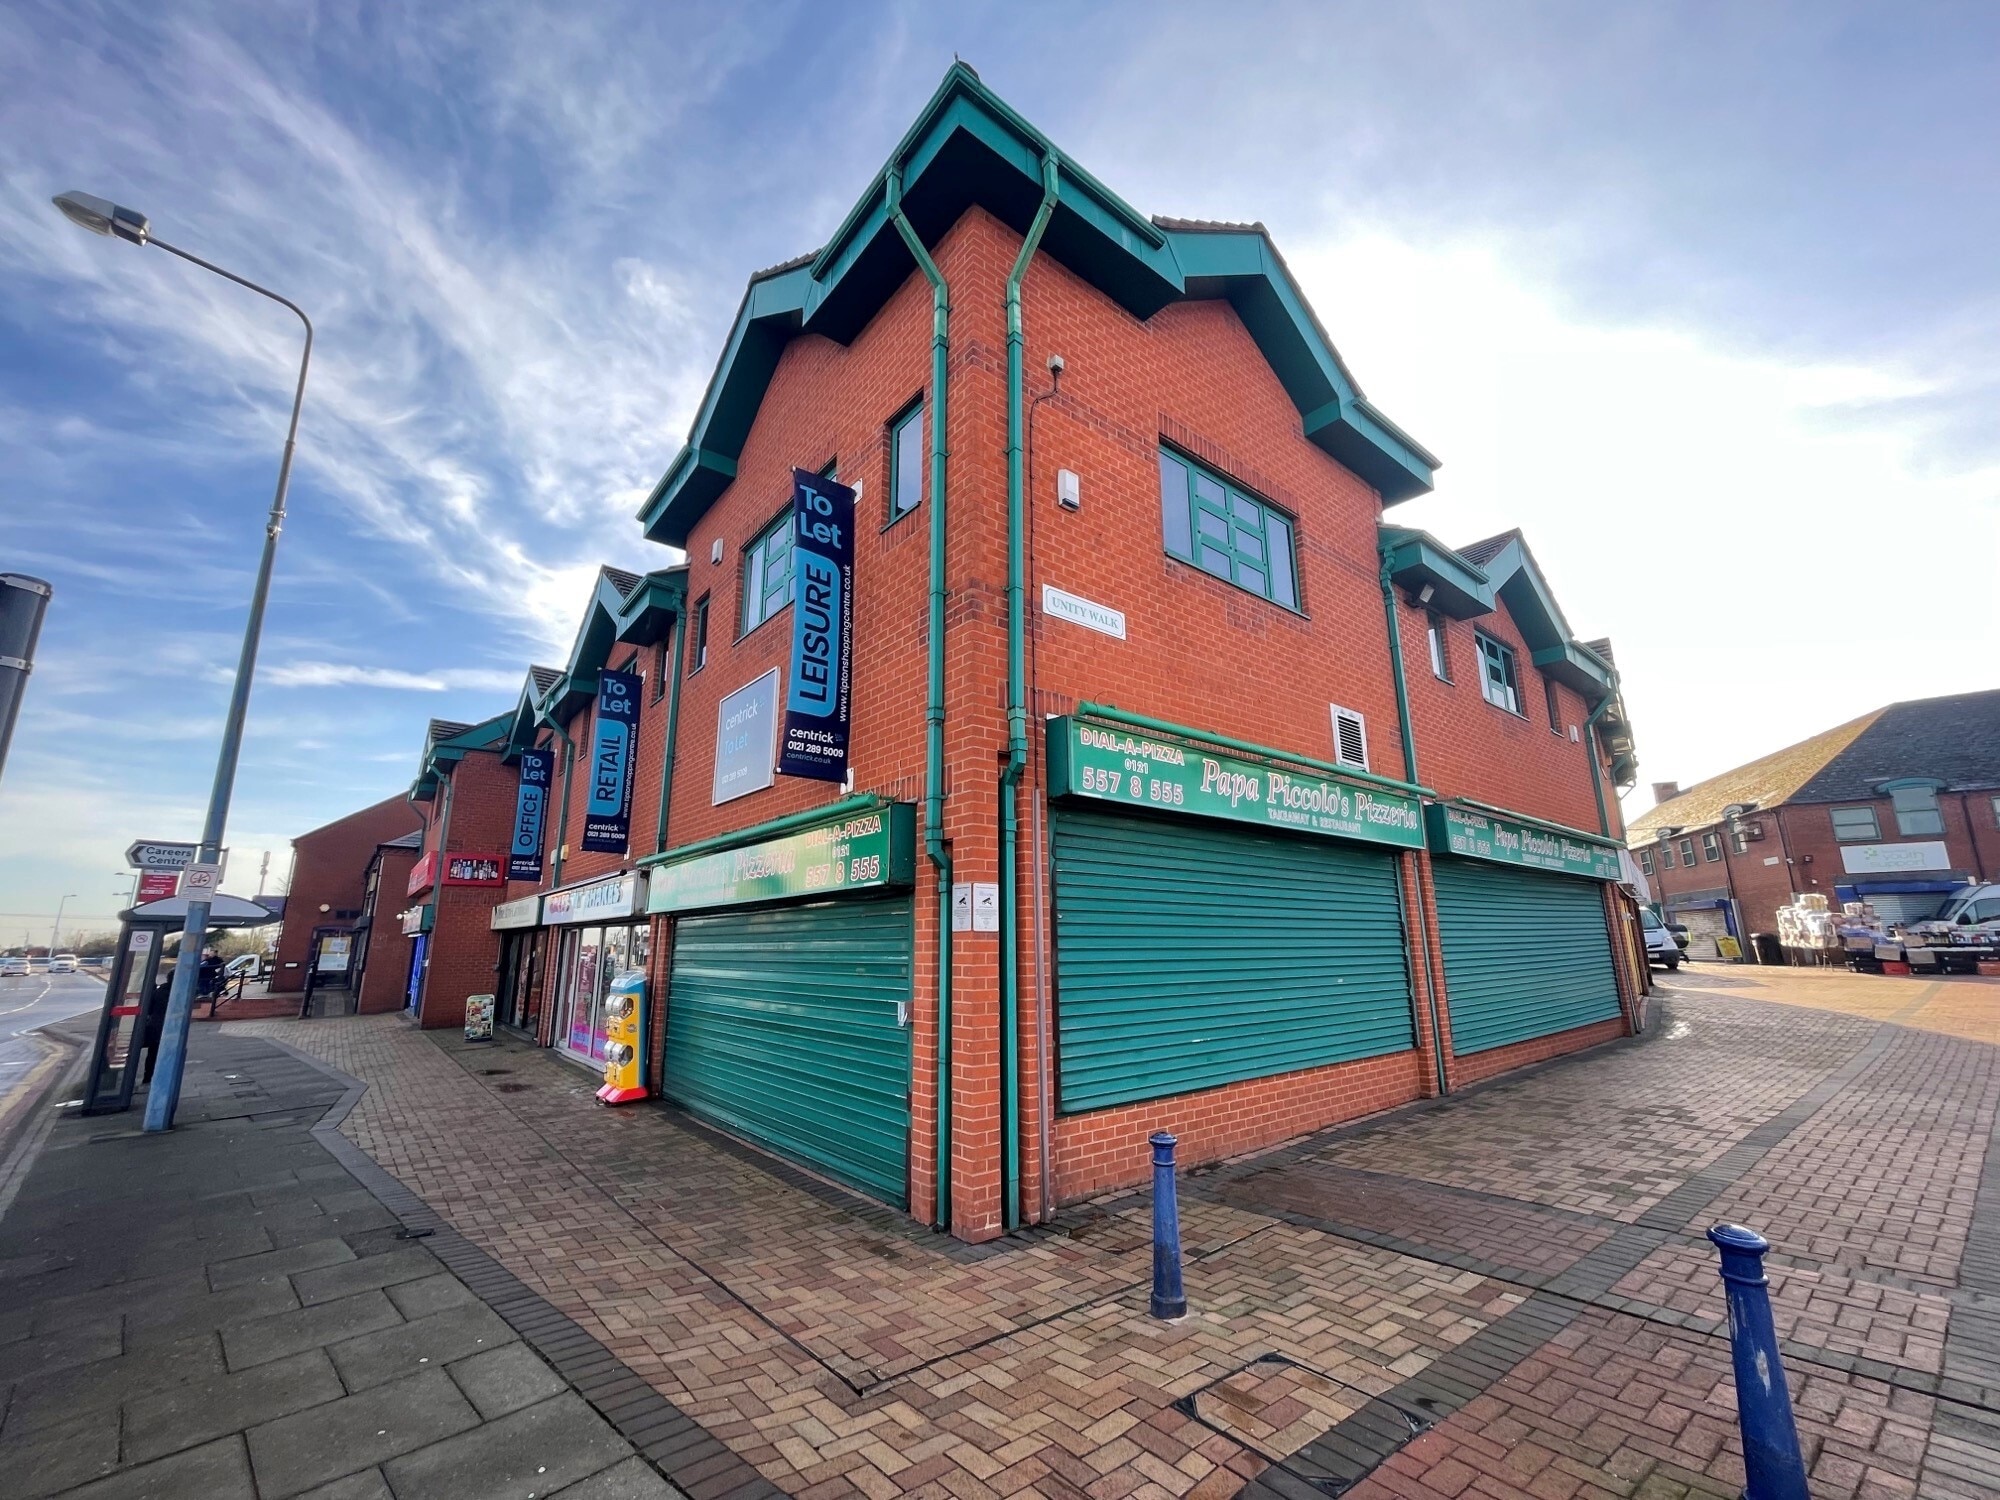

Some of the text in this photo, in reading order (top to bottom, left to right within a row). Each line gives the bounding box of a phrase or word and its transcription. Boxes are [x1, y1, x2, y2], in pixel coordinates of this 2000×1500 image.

[800, 484, 833, 516] To
[800, 511, 842, 550] Let
[1052, 597, 1119, 629] UNITY WALK
[799, 562, 832, 703] LEISURE
[839, 564, 851, 722] www.tiptonshoppingcentre.co.uk
[604, 678, 626, 695] To
[601, 695, 631, 715] Let
[725, 699, 758, 731] centrick
[724, 730, 748, 756] To Let
[788, 740, 844, 758] 0121 289 5009
[790, 728, 834, 744] centrick
[1080, 727, 1185, 766] DIAL-A-PIZZA
[525, 755, 542, 768] To
[596, 735, 621, 802] RETAIL
[786, 752, 831, 764] centrick.co.uk
[1124, 758, 1149, 774] 0121
[523, 768, 546, 781] Let
[1082, 766, 1184, 805] 557 8 555
[1200, 758, 1418, 830] Papa Piccolo's Pizzeria
[518, 792, 538, 847] OFFICE
[588, 823, 619, 832] centrick
[1267, 807, 1310, 825] TAKEAWAY
[805, 815, 882, 849] DIAL-A-PIZZA
[1493, 823, 1519, 854] Papa
[146, 846, 192, 857] Careers
[147, 855, 188, 866] Centre
[732, 847, 796, 883] Pizzeria
[832, 844, 850, 859] 0121
[805, 855, 880, 888] 557 8 555
